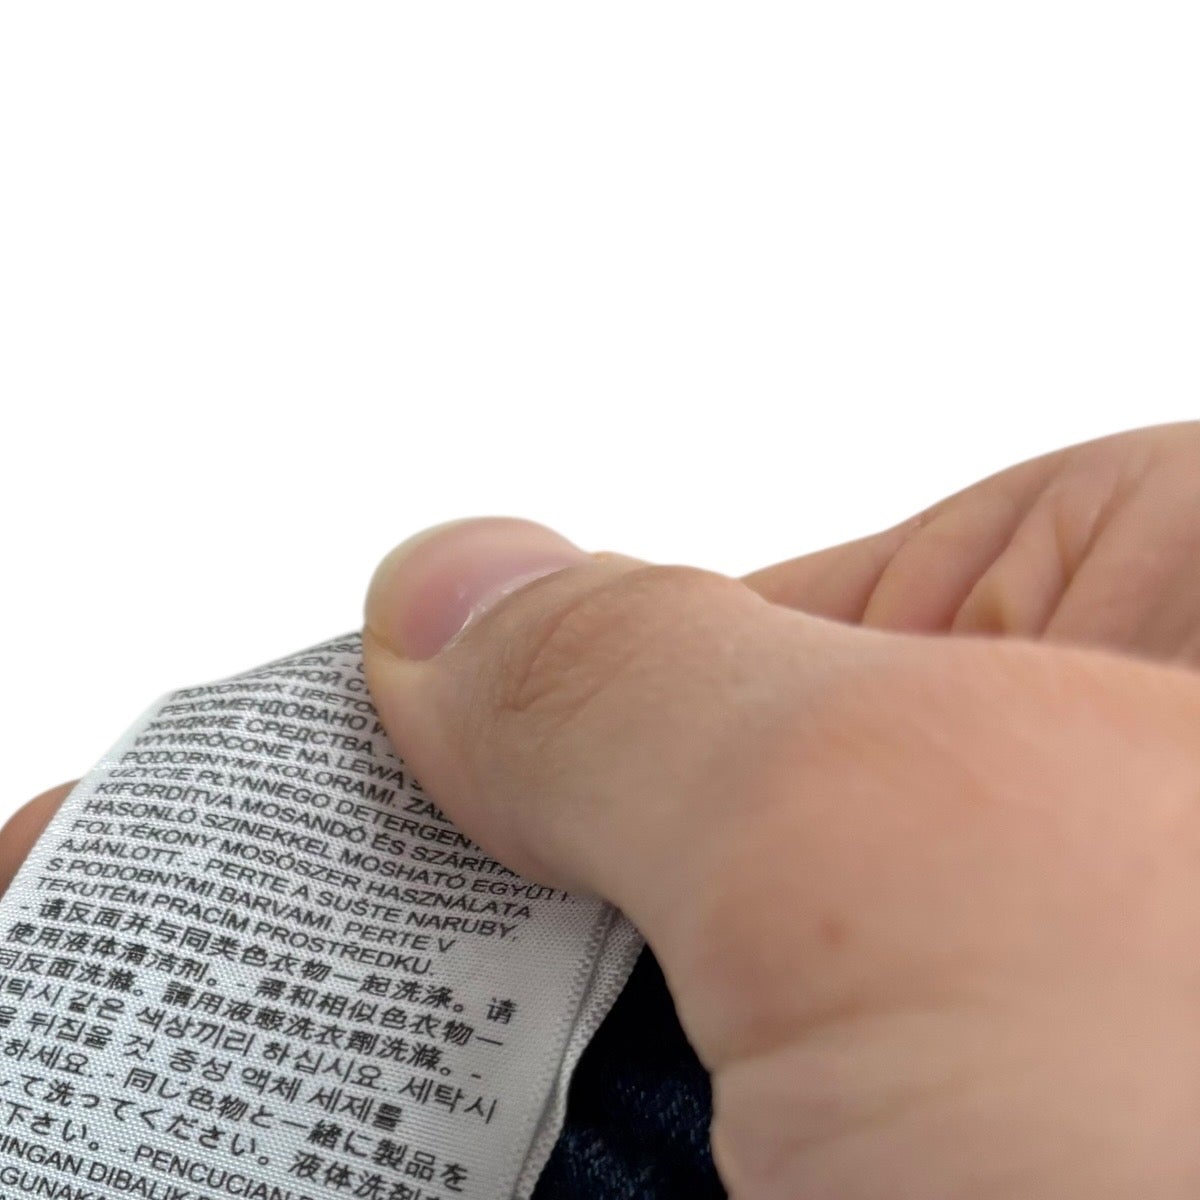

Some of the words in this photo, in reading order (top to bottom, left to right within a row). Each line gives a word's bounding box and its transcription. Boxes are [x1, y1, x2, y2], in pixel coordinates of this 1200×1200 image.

[158, 699, 368, 731] РЕКОМЕНДОВАНО
[292, 685, 379, 717] ЦВЕТО
[120, 751, 263, 772] PODOBNYMI
[265, 763, 397, 807] KOLORAMI.
[296, 747, 329, 766] NA
[83, 799, 197, 824] HASONLÓ
[339, 848, 467, 891] MOSHATÓ
[95, 781, 233, 810] KIFORDÍTVA
[239, 798, 366, 844] MOSANDÓ
[371, 832, 404, 857] ÉS
[335, 799, 481, 851] DETERGEN
[37, 876, 149, 907] TEKUTÉM
[150, 892, 251, 934] PRACÍM
[46, 858, 64, 873] S
[66, 859, 216, 898] PODOBNÝMI
[217, 885, 336, 934] BARVAMI.
[343, 921, 431, 952] PERTE
[438, 937, 457, 954] V
[56, 838, 183, 867] AJÁNLOTT.
[204, 858, 290, 894] PERTE
[292, 884, 309, 900] A
[405, 911, 518, 942] NARUBY,
[70, 819, 218, 849] FOLYÉKONY
[218, 839, 362, 892] MOSÓSZER
[365, 880, 532, 919] HASZNÁLATA
[26, 1012, 113, 1051] 뒤집을
[122, 1034, 155, 1063] 것.
[168, 1048, 233, 1083] 중성
[241, 1066, 303, 1104] 액체
[306, 1086, 403, 1132] 세제를
[135, 1006, 255, 1056] 색상끼리
[400, 1076, 498, 1124] 세탁시
